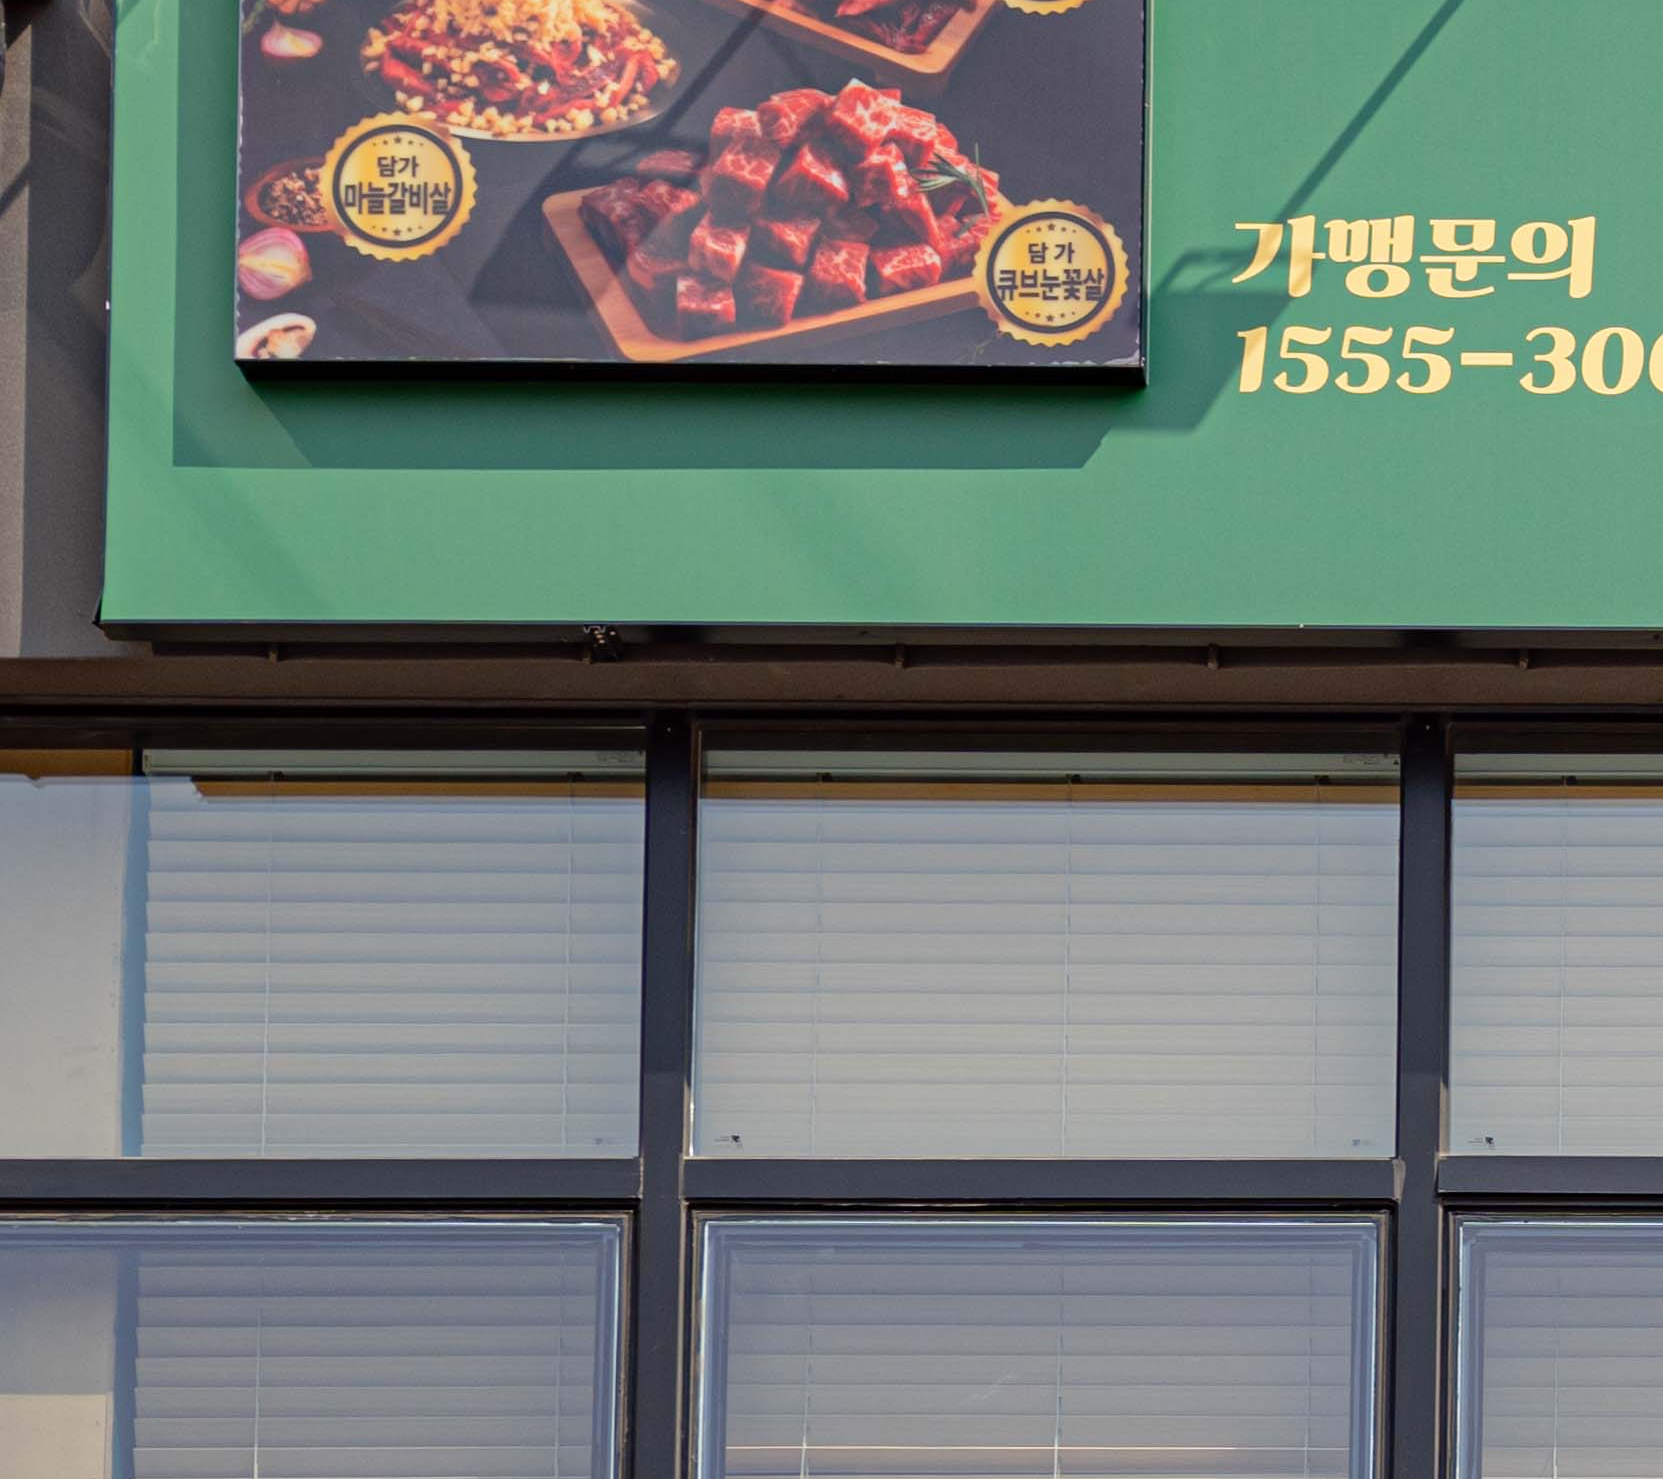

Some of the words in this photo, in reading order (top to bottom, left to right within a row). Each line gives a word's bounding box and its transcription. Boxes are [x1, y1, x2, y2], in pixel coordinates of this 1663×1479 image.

[377, 155, 420, 178] 담가
[343, 181, 452, 216] 마늘갈비살
[1231, 213, 1599, 299] 가맹문의
[997, 267, 1105, 302] 큐브눈꽃살
